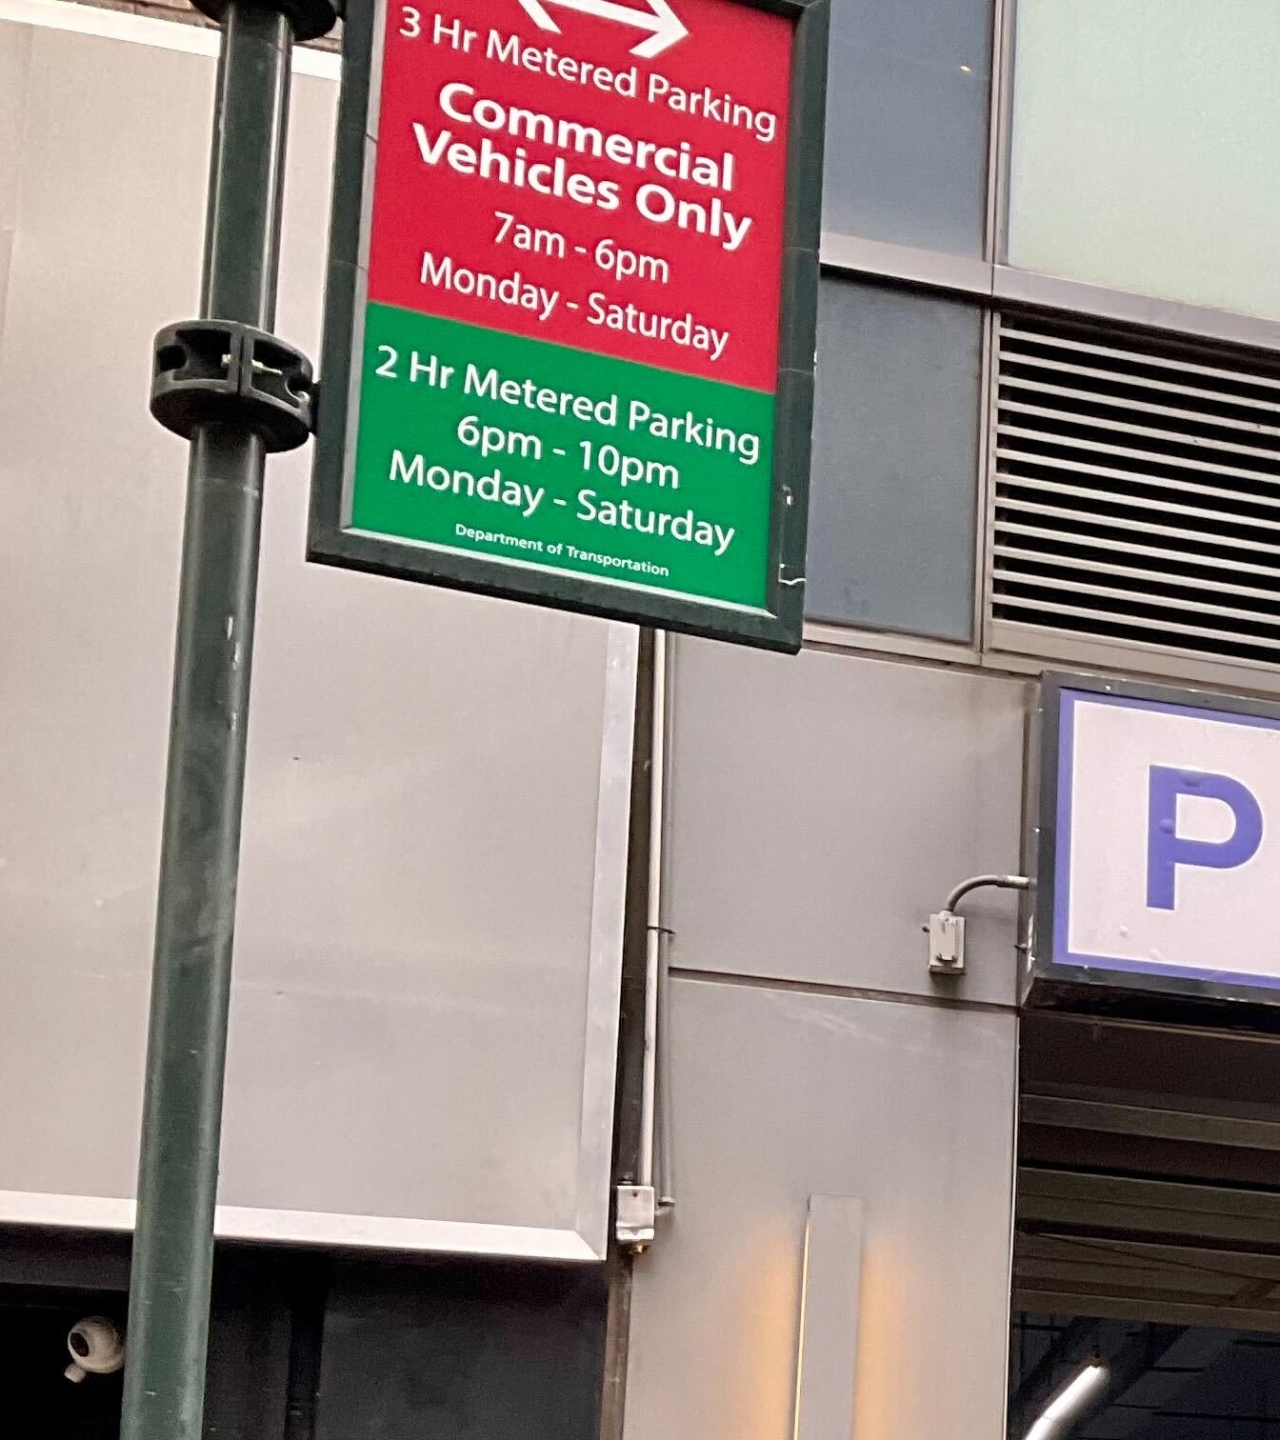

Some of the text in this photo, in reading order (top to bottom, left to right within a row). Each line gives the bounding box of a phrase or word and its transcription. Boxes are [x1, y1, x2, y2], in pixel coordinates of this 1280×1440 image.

[399, 7, 778, 141] 3 Hr Metered Parking
[412, 122, 752, 251] Vehicles Only
[438, 82, 734, 191] Commercial
[494, 212, 566, 258] 7am
[594, 238, 669, 283] 6pm
[420, 252, 559, 321] Monday
[587, 294, 729, 361] Saturday
[376, 346, 761, 464] 2 Hr Metered Parking
[457, 416, 541, 462] 6pm
[578, 439, 680, 489] 10pm
[389, 451, 546, 517] Monday
[577, 489, 735, 556] Saturday
[455, 523, 669, 576] Department of Transportation
[1145, 765, 1264, 912] P
